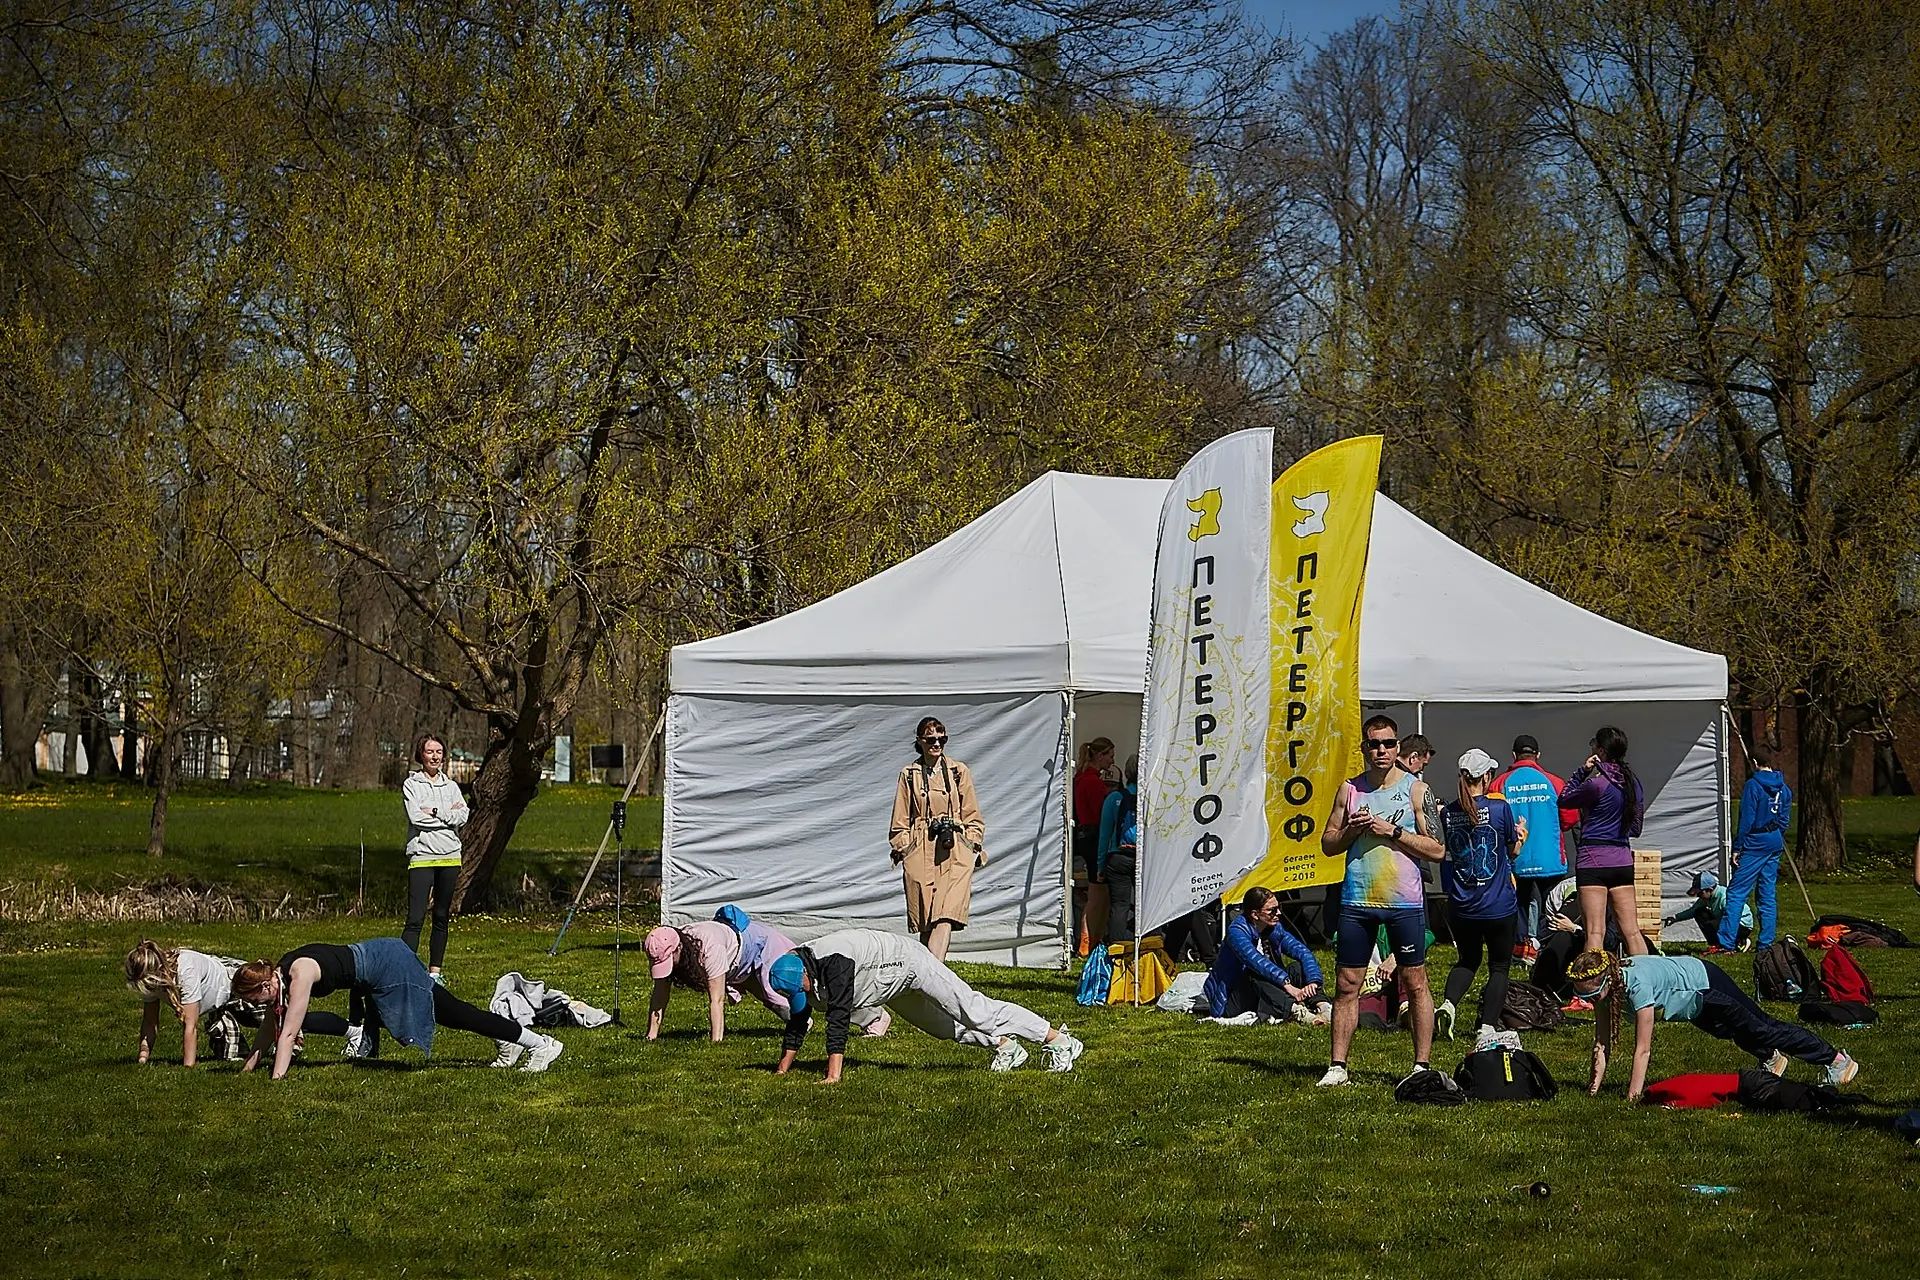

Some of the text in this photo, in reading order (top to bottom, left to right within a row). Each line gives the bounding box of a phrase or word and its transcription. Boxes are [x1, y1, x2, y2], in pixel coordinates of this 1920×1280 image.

[1284, 552, 1318, 843] ПЕТЕРГОФ
[1191, 555, 1223, 863] ПЕТЕРГОФ
[1508, 783, 1548, 792] RUSSIA
[1283, 853, 1316, 864] бегаем
[1283, 862, 1316, 873] вместе
[1191, 872, 1223, 884] бегаем
[1292, 871, 1316, 882] 2018
